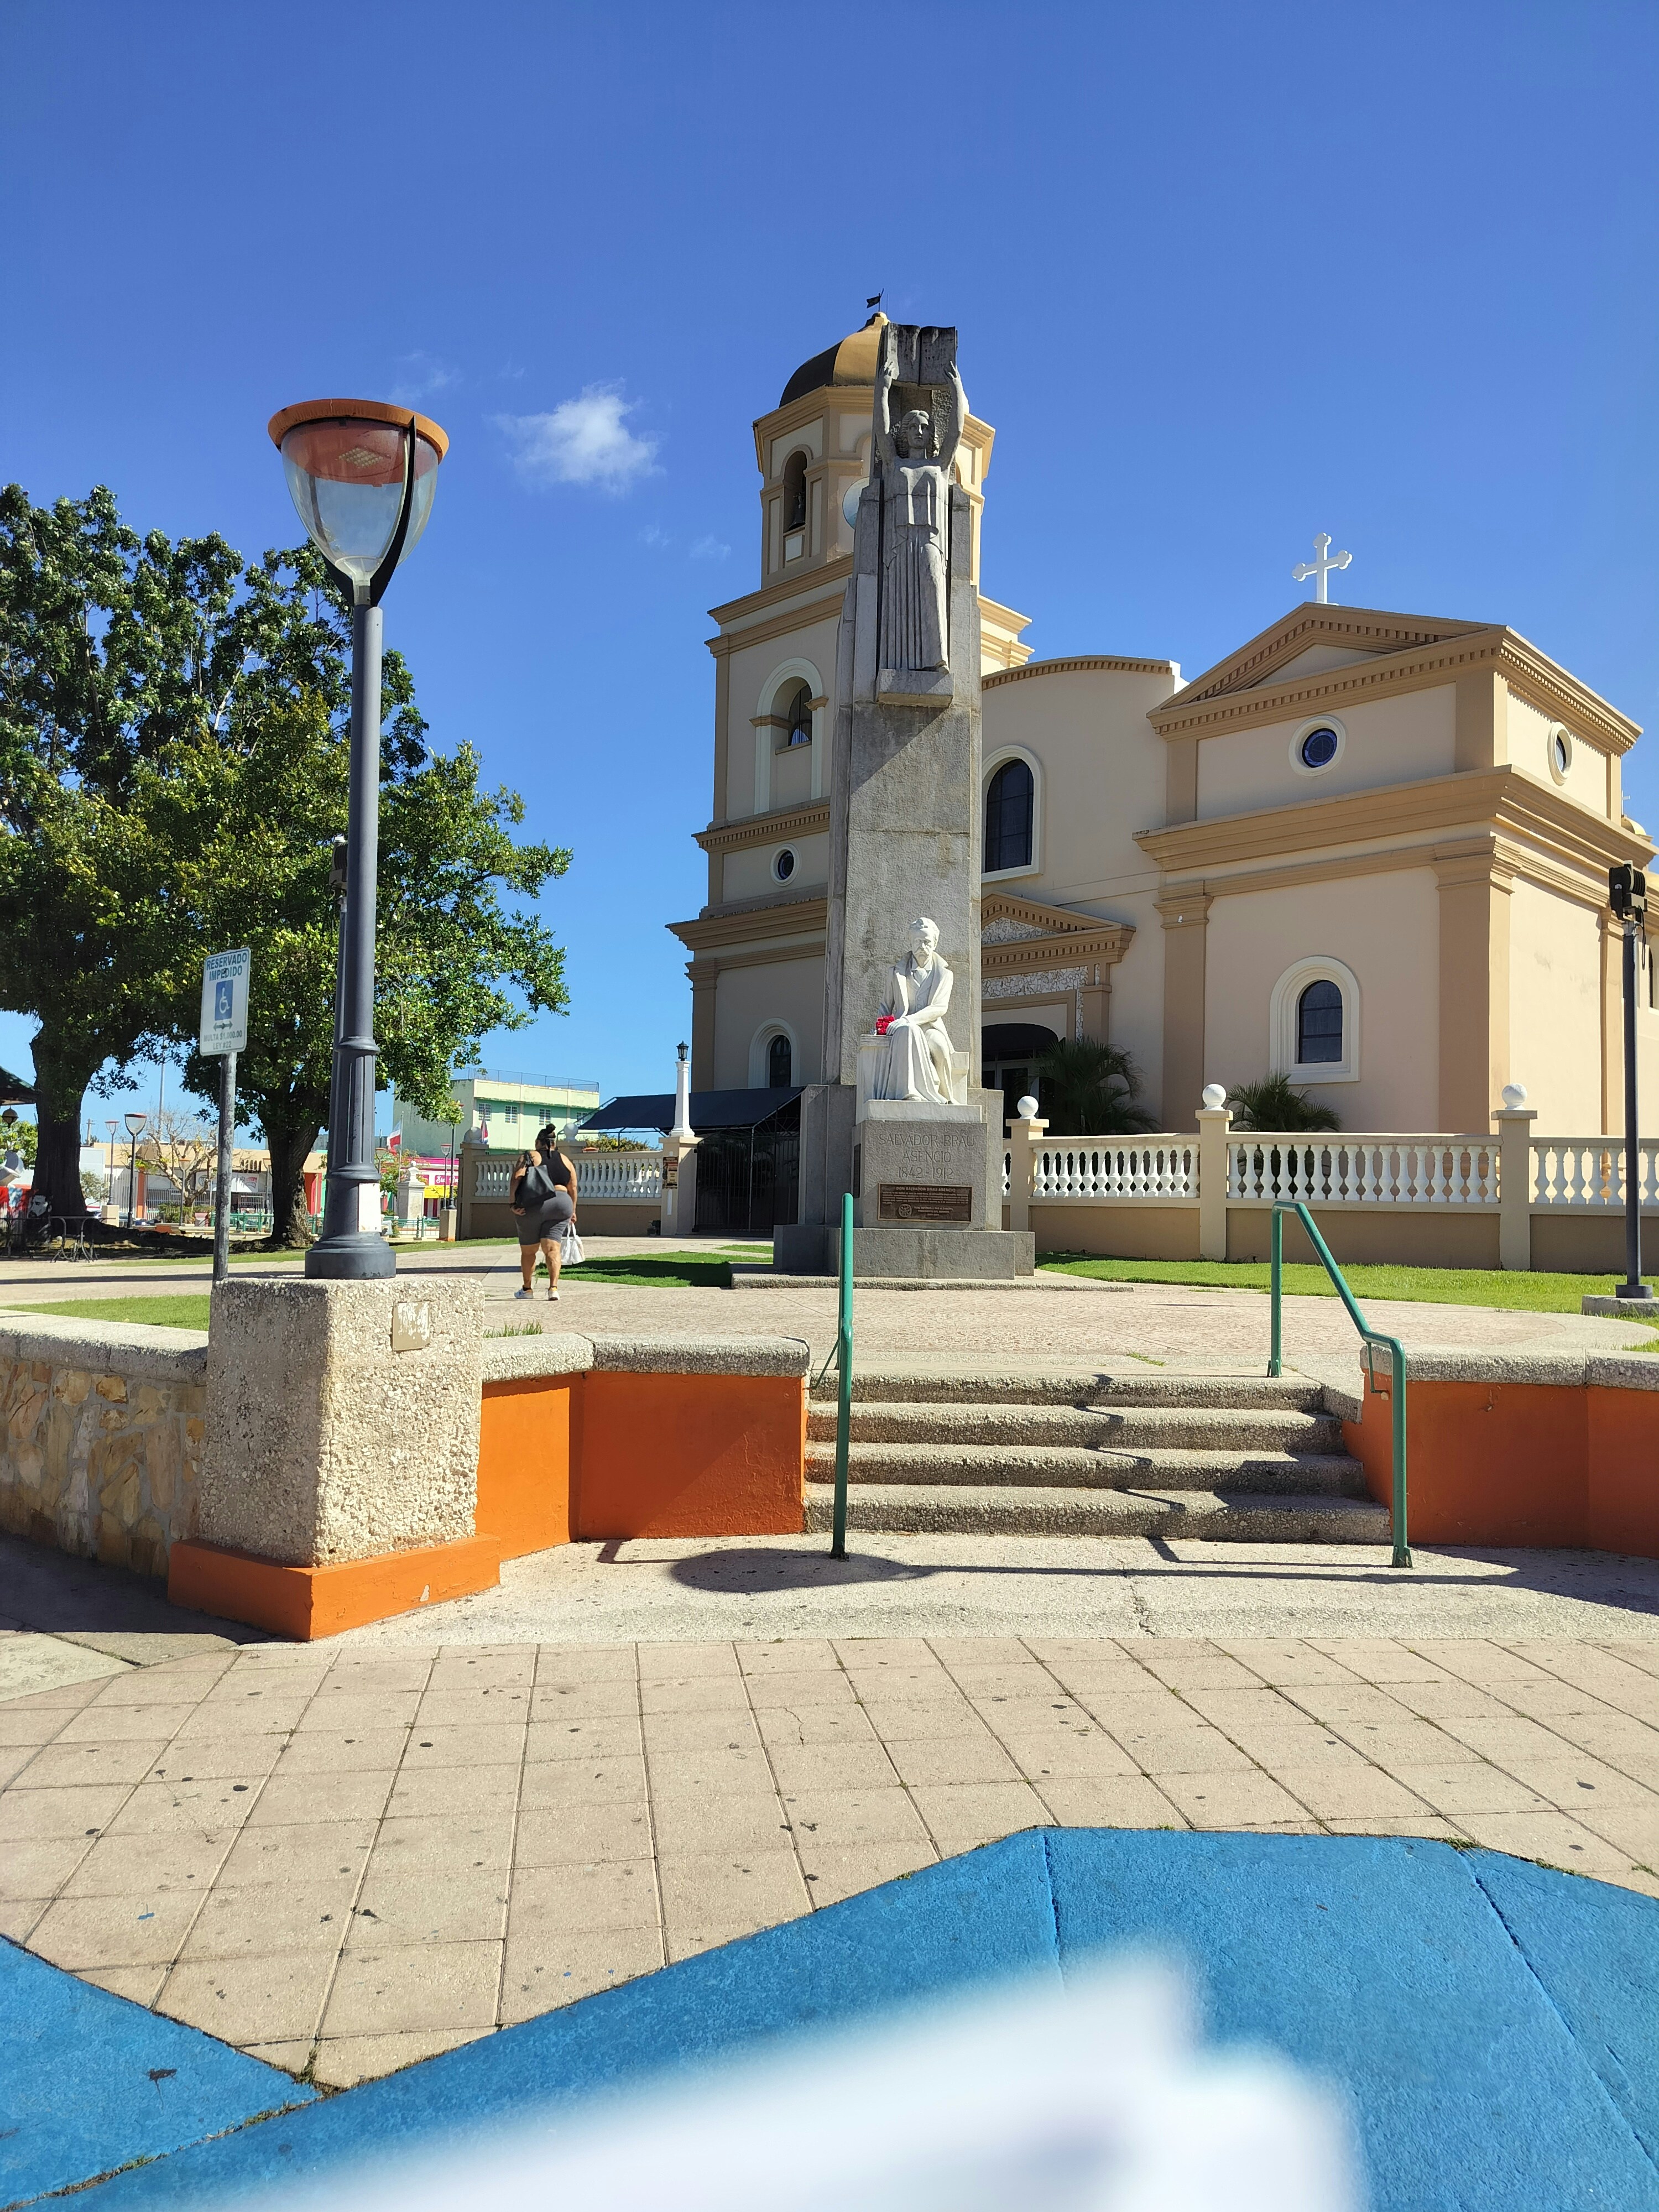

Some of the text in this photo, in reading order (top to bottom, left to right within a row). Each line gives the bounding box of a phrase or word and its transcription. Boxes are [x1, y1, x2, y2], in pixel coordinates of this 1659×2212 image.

[206, 952, 247, 971] RESERVADO
[209, 966, 242, 981] IMPEDIDO
[204, 1034, 219, 1042] MULTA
[879, 1133, 938, 1147] SALVADOR
[902, 1150, 951, 1163] ASENCIO
